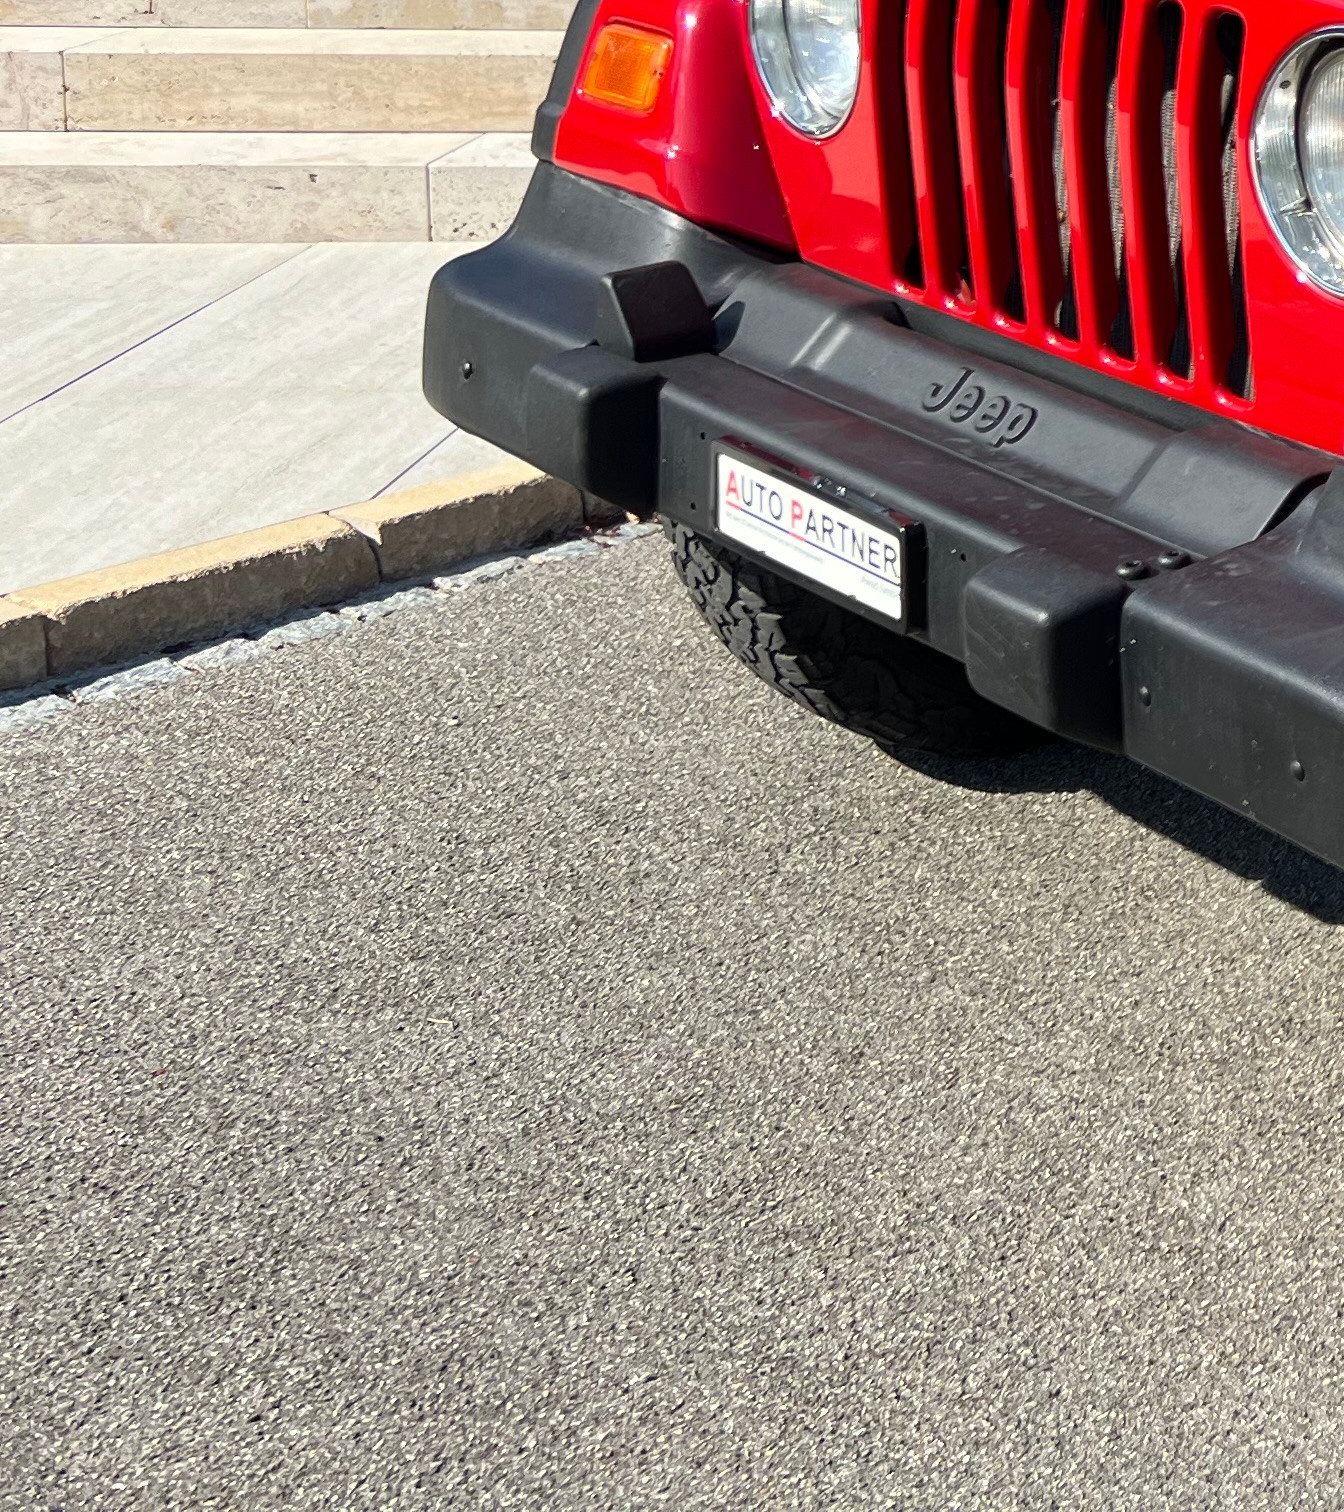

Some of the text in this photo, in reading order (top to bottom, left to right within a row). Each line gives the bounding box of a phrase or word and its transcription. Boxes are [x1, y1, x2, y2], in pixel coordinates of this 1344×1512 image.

[922, 366, 1038, 448] Jeep
[726, 471, 783, 521] AUTO
[791, 499, 901, 578] PARTNER
